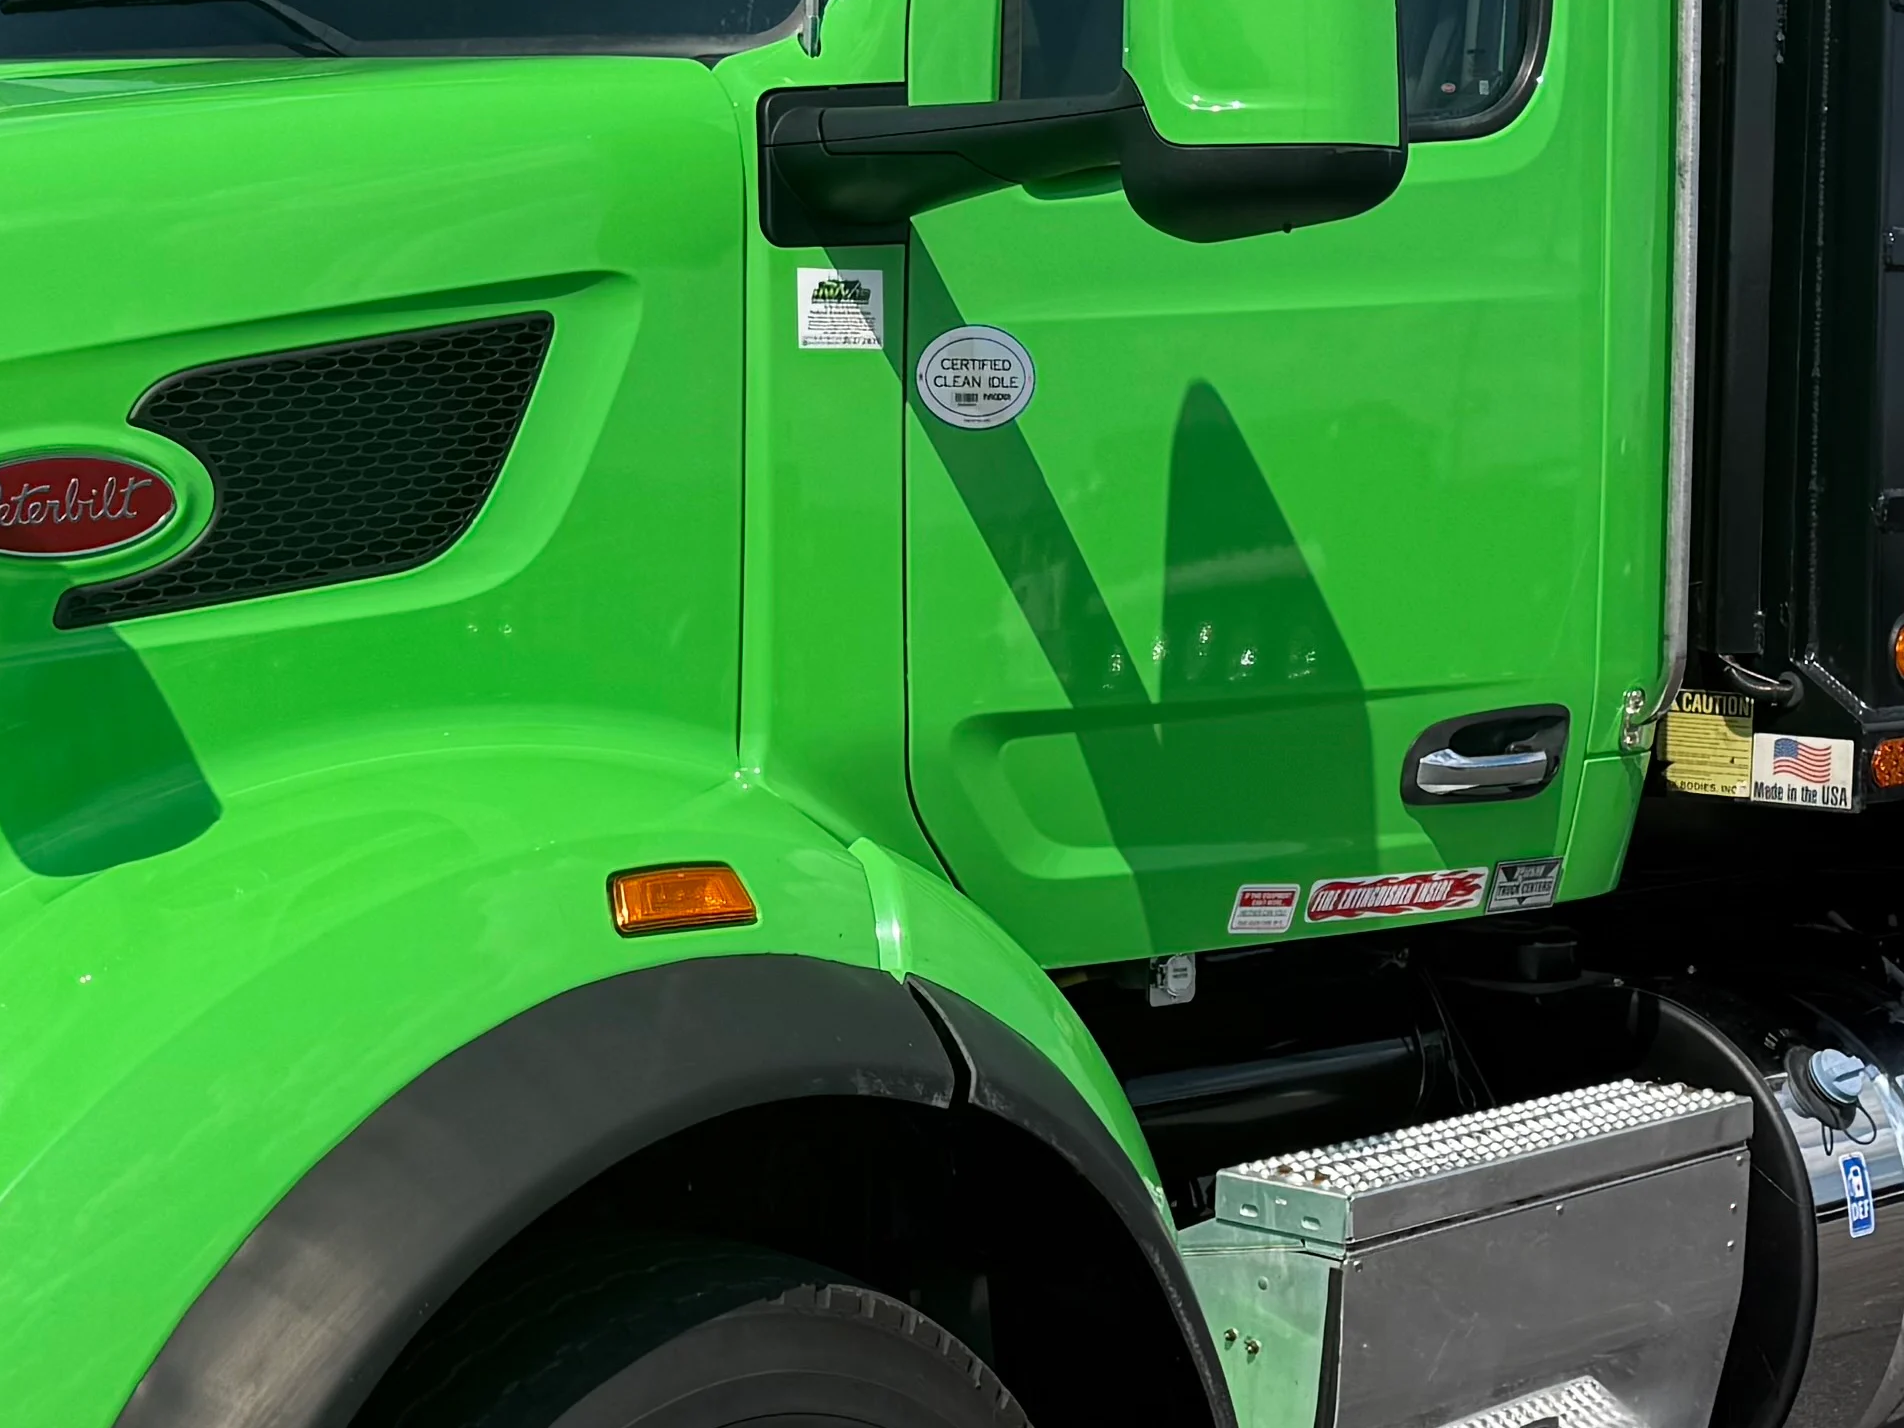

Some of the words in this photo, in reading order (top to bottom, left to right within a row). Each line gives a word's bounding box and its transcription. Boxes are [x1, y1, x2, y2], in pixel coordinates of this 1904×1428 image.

[940, 358, 1012, 372] CERTIFIED
[933, 375, 982, 389] CLEAN
[988, 375, 1019, 389] IDLE
[1682, 692, 1752, 717] CAUTION
[1753, 781, 1784, 801] Made
[1787, 785, 1797, 803] in
[1801, 785, 1818, 804] the
[1821, 785, 1848, 807] USA
[1311, 889, 1341, 913] FIRE
[1415, 879, 1454, 904] INSIDE
[1851, 1199, 1869, 1222] DEF
